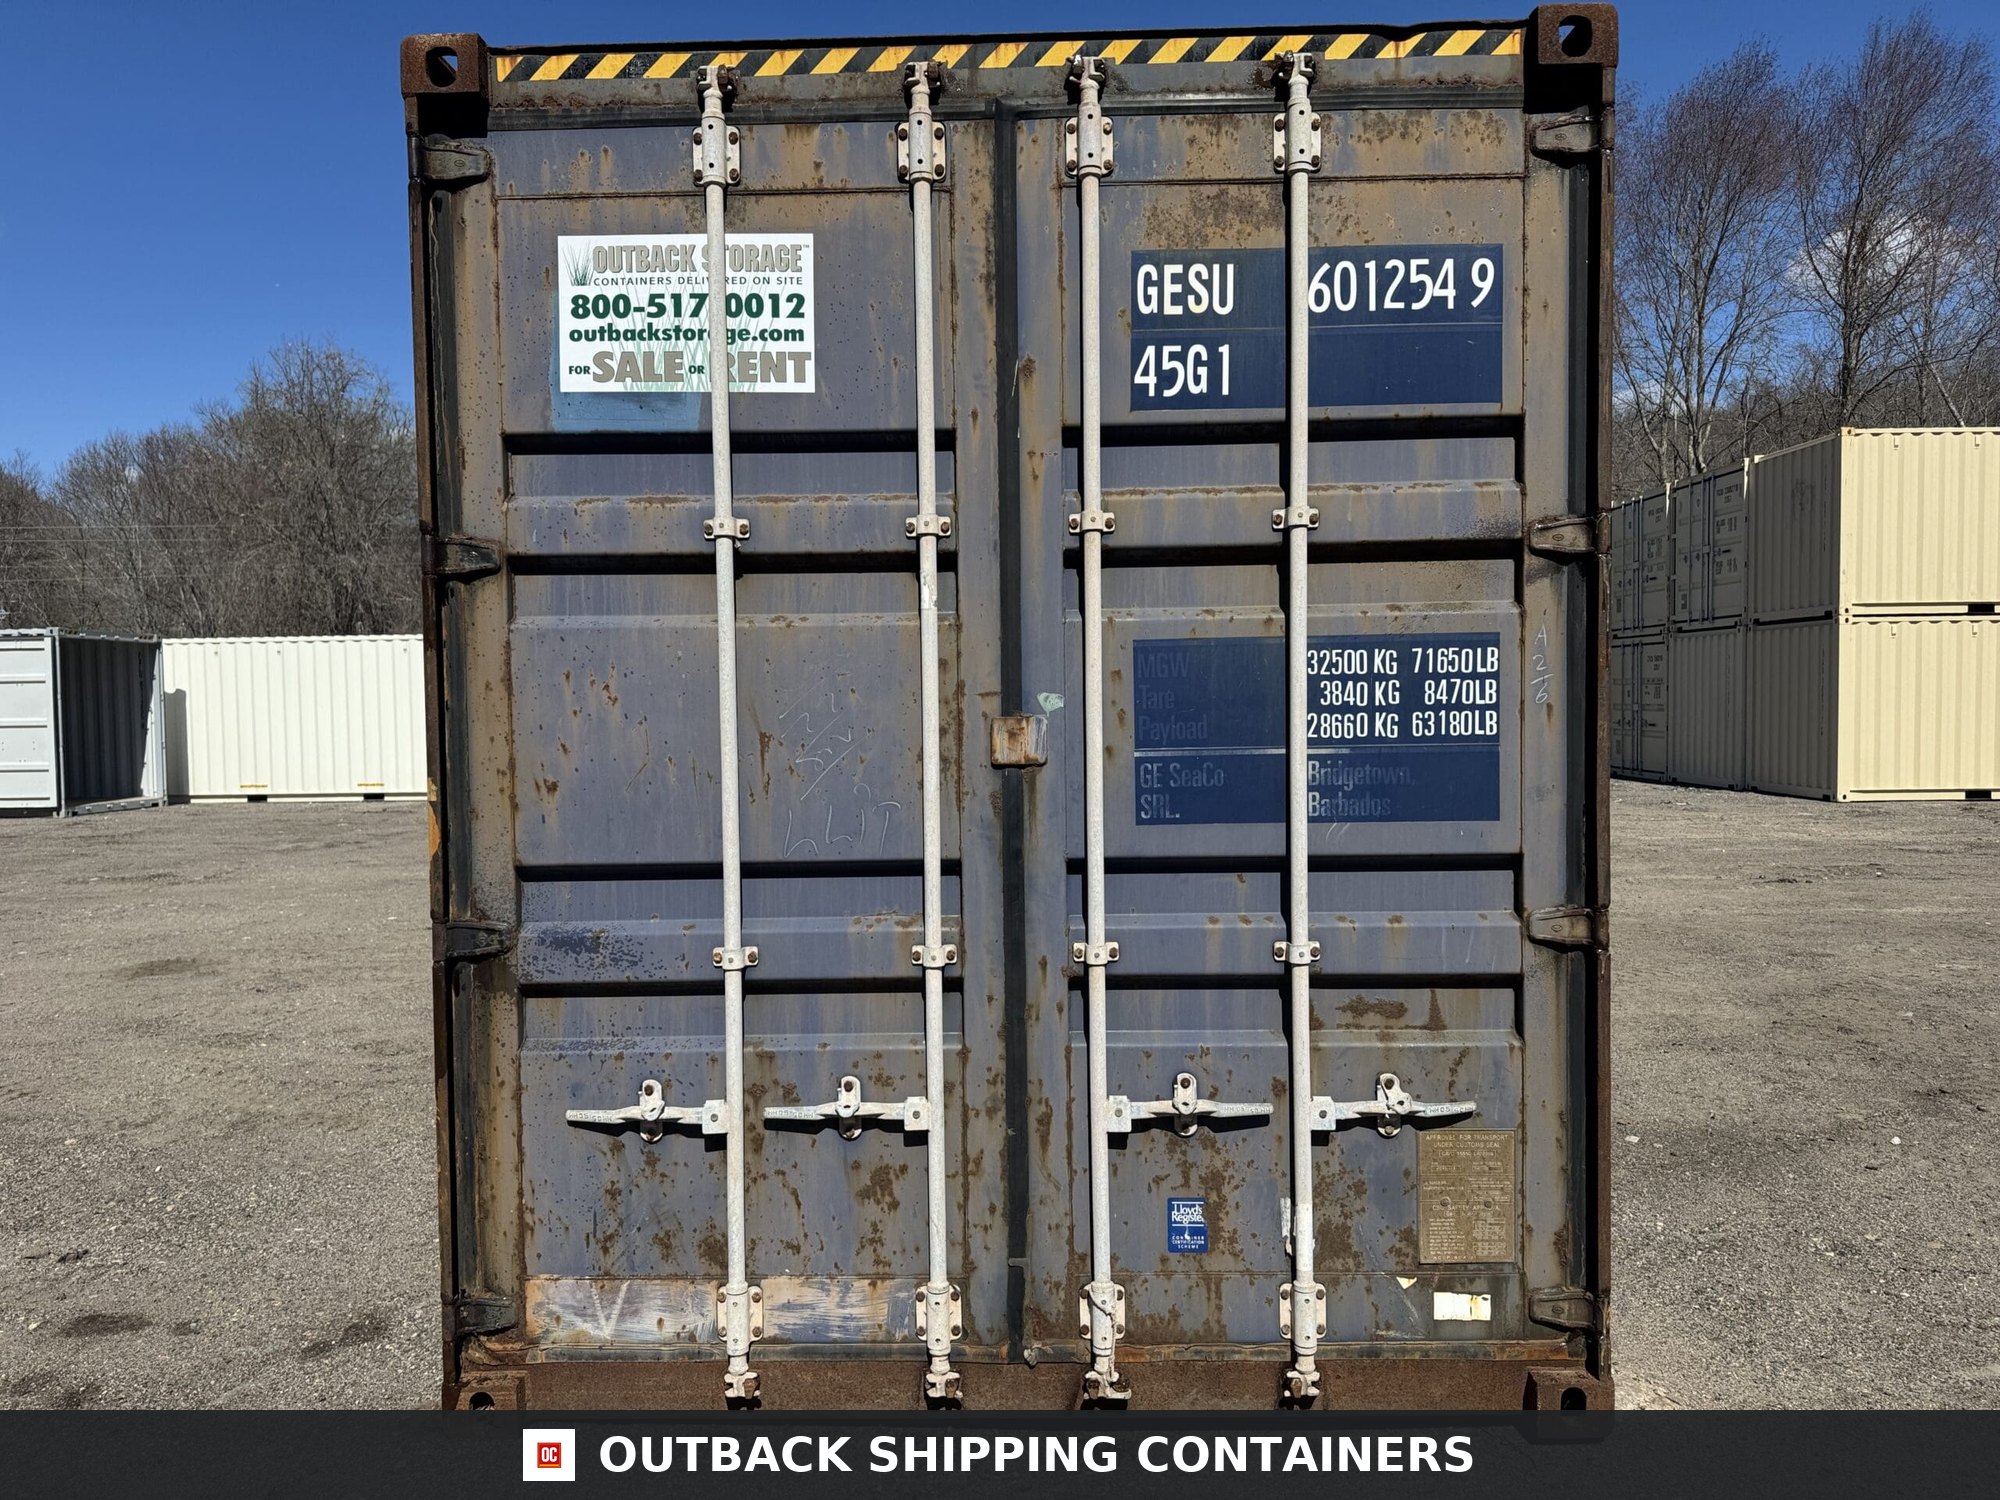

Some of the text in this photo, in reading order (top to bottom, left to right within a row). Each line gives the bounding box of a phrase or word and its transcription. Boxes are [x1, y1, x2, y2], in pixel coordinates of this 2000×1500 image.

[592, 244, 697, 273] OUTBACK
[701, 244, 803, 273] SORAGE
[593, 276, 803, 286] CONTAINERS DELIRED ON SITE
[1136, 257, 1495, 315] GESU 601254 9
[570, 292, 806, 319] 800-5170012
[569, 322, 805, 345] outbackstorge.com
[568, 365, 591, 375] FOR
[592, 350, 684, 383] SALE
[688, 365, 705, 375] OR
[1134, 343, 1230, 397] 45G1
[1137, 652, 1190, 680] MGW
[1307, 649, 1368, 675] 32500
[1374, 648, 1398, 675] KG
[1138, 685, 1175, 710] Tare
[1320, 681, 1368, 706] 3840
[1375, 680, 1400, 705] KG
[1138, 714, 1208, 745] Payload
[1308, 713, 1368, 738] 28660
[1375, 712, 1399, 738] KG
[1140, 763, 1163, 788] GE
[1169, 762, 1225, 788] SeaCo
[1140, 793, 1181, 819] SRL.
